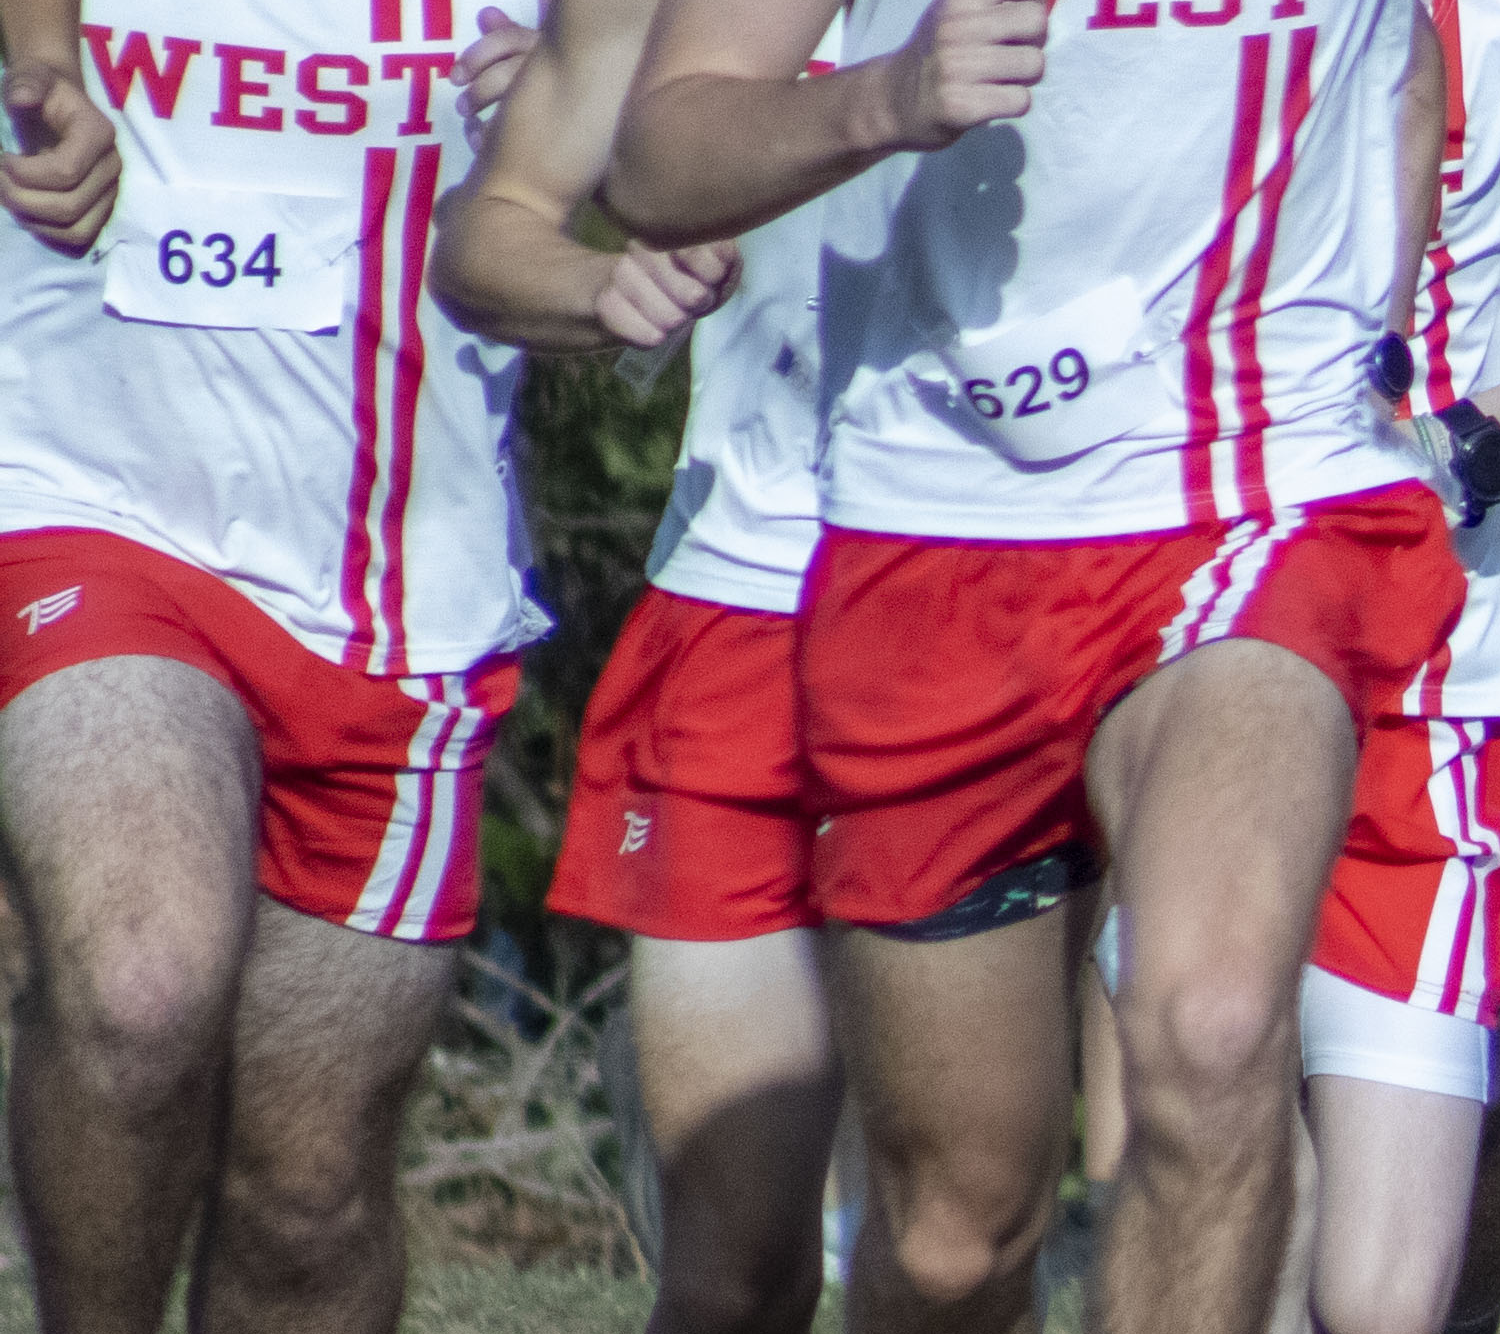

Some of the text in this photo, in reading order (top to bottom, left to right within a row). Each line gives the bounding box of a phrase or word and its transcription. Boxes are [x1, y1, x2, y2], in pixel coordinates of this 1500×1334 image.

[80, 23, 456, 136] WEST
[158, 229, 282, 288] 634
[962, 347, 1090, 420] 629
